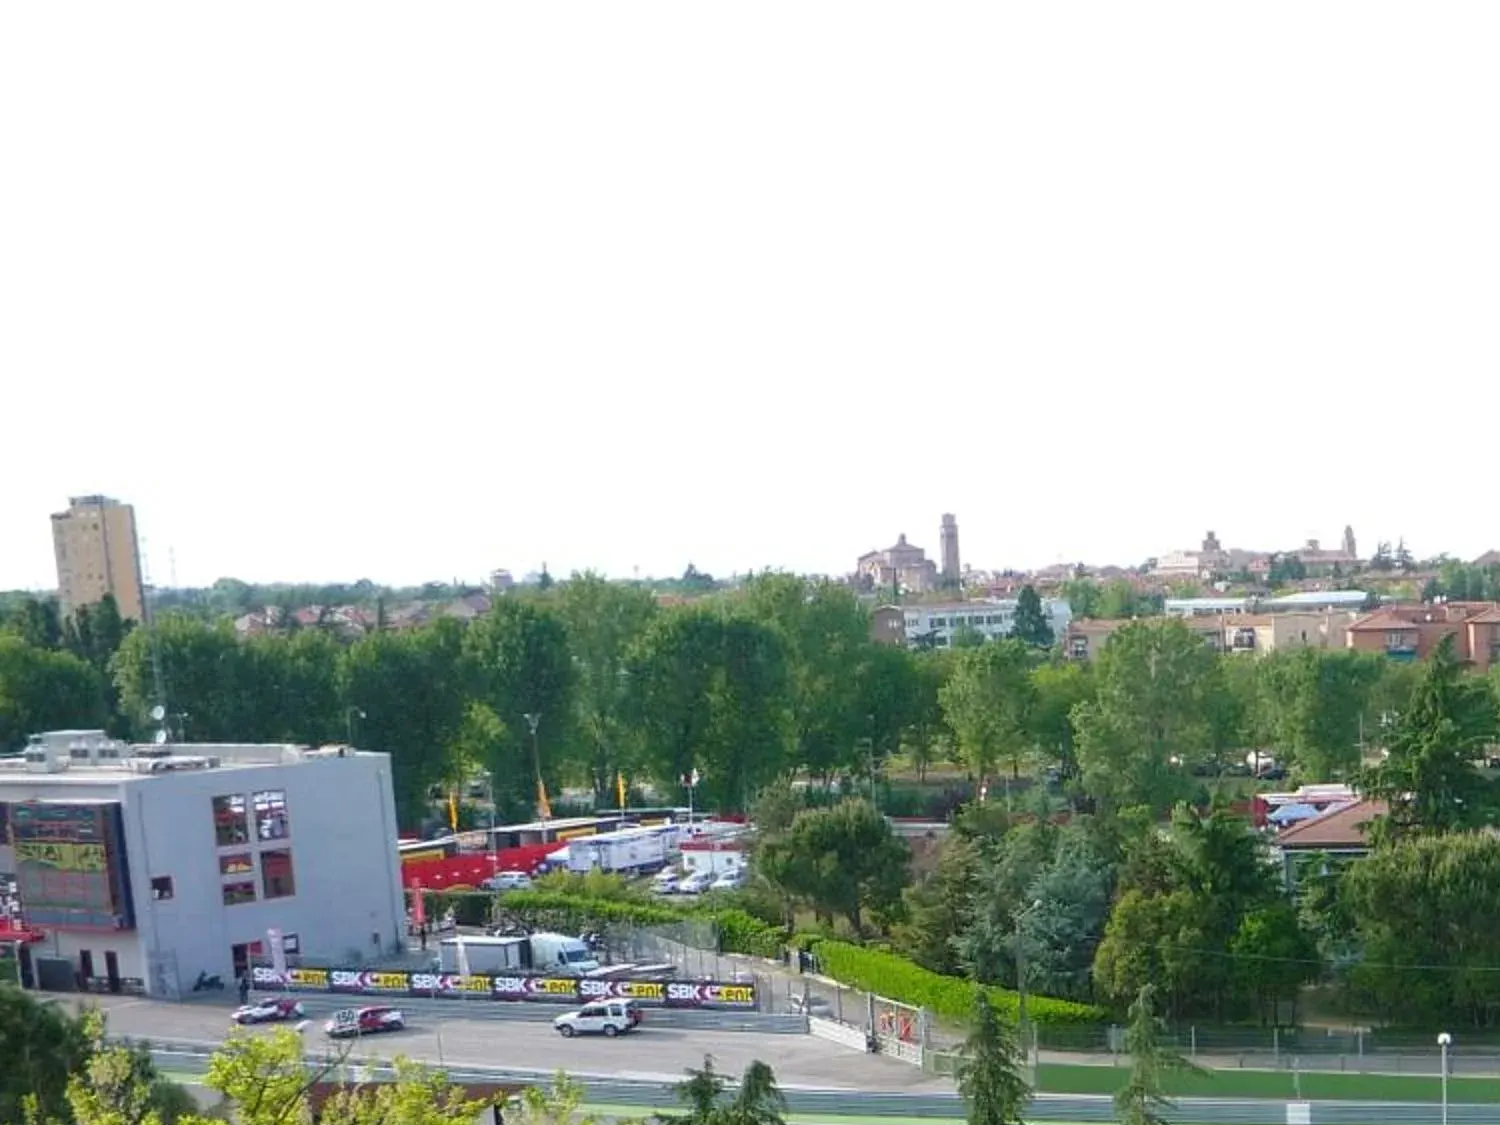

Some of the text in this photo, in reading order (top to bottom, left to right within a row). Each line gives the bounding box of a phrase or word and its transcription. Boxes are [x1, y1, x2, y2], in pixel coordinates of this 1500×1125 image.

[332, 970, 364, 986] SBK
[411, 974, 443, 989] SBK
[495, 977, 527, 993] SBK
[580, 980, 613, 996] SBK
[667, 983, 701, 999] SBK
